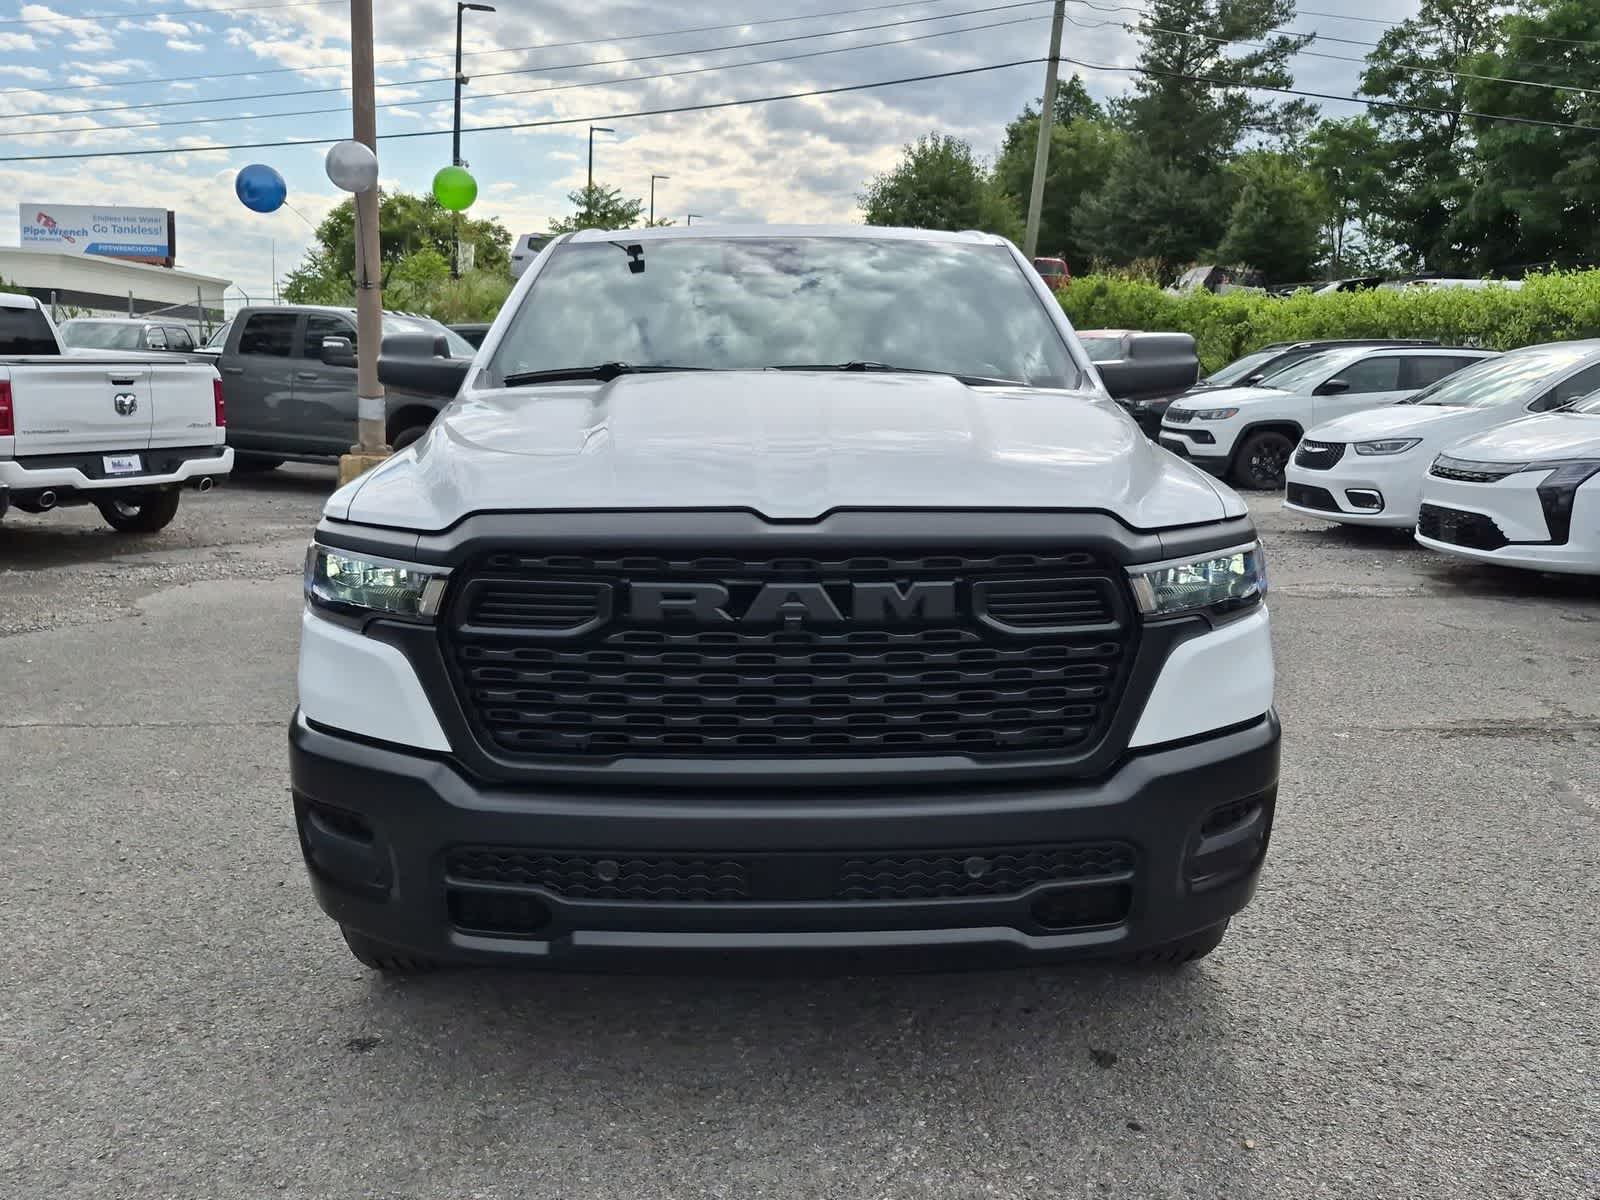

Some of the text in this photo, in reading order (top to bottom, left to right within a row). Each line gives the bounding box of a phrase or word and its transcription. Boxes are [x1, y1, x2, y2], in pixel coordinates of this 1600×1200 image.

[23, 225, 89, 237] Pipe Wrench
[92, 223, 162, 235] Go Tankless!
[630, 582, 954, 621] RAM
